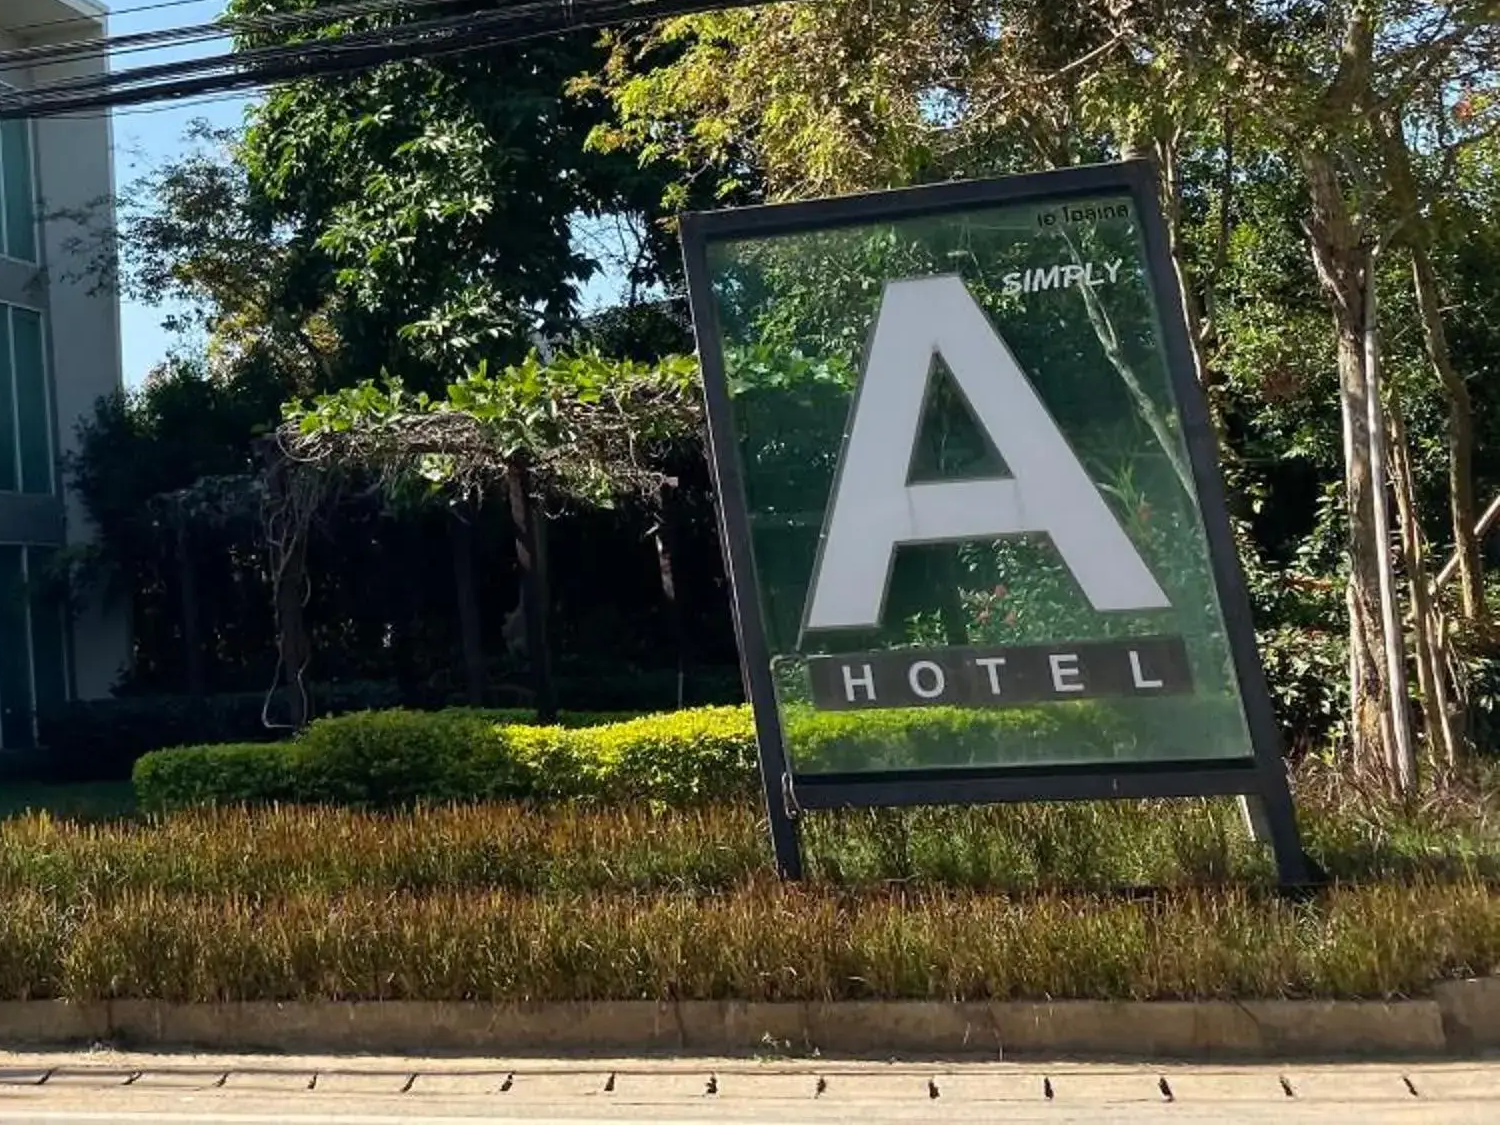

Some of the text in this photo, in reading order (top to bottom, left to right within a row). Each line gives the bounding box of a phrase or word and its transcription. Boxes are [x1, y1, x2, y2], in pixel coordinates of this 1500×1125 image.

[1002, 258, 1122, 295] SIMPLY
[805, 273, 1172, 629] A
[841, 650, 1163, 702] HOTEL
